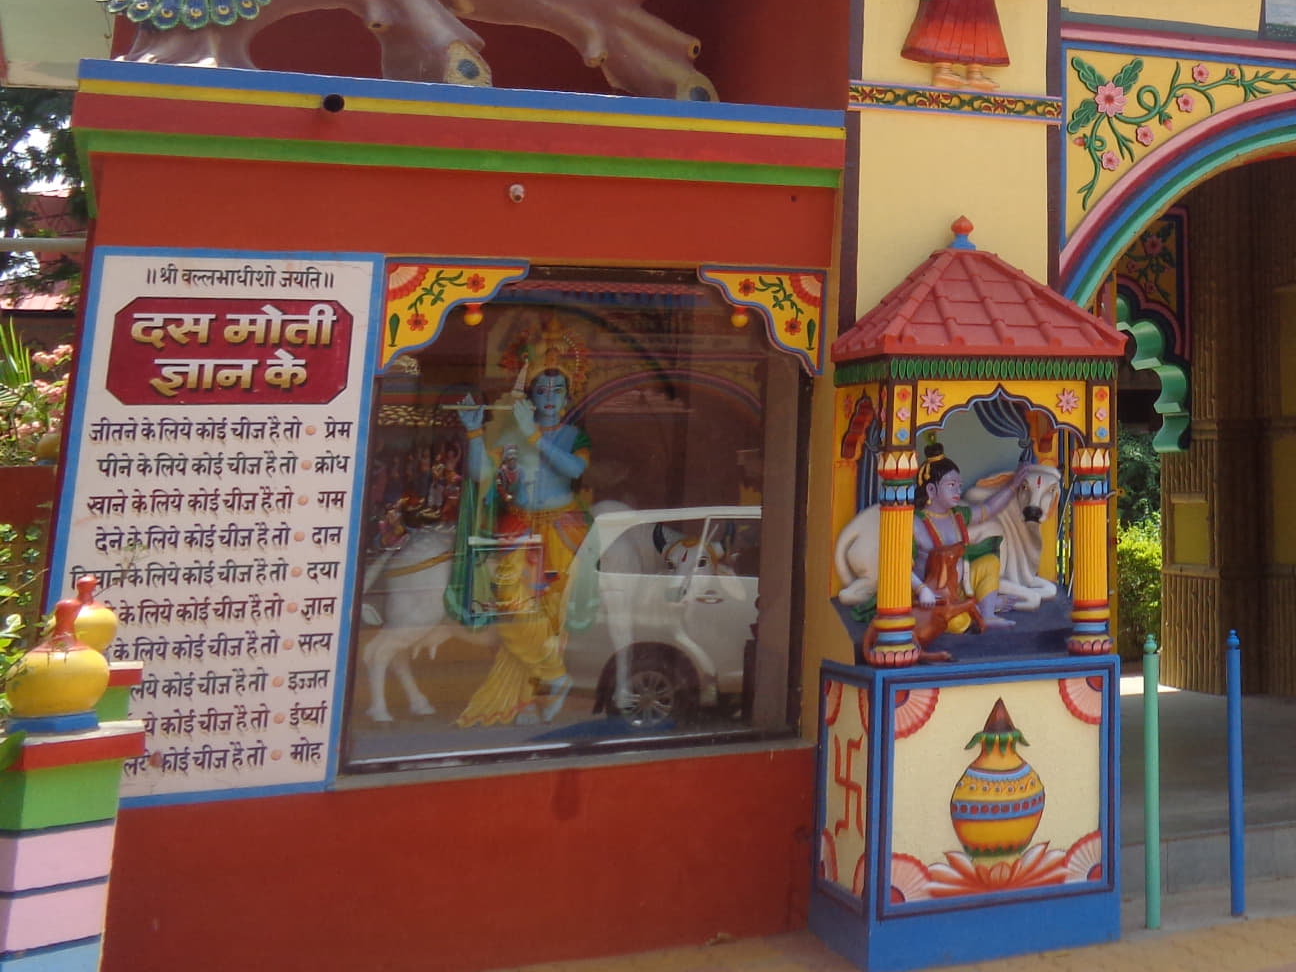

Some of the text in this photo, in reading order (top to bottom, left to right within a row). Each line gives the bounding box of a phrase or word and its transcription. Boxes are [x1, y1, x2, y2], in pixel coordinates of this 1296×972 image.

[181, 264, 276, 288] वल्लभाधीशो
[130, 303, 338, 349] दस मोती
[149, 348, 309, 397] ज्ञान के
[89, 416, 354, 443] जीतने के लिये कोई चीज है तो प्रेम
[97, 450, 351, 480] पीने के लिये कोई चीज है तो क्रोध
[86, 486, 347, 515] खाने के लिये कोई चीज है तो गम
[95, 527, 129, 554] देने
[146, 525, 181, 550] लिये
[183, 524, 217, 553] कोई
[217, 525, 254, 549] चीज
[255, 522, 270, 549] है
[271, 522, 291, 547] तो
[311, 527, 343, 546] दान
[145, 561, 182, 586] लिये
[182, 559, 216, 587] कोई
[217, 559, 254, 584] चीज
[255, 558, 269, 586] है
[270, 557, 290, 581] तो
[306, 562, 340, 581] दया
[119, 593, 337, 627] के लिये कोई चीज है तो ज्ञान
[113, 630, 333, 662] के लिये कोई चीज है तो सत्य
[162, 666, 330, 699] कोई चीज है तो इज्जत
